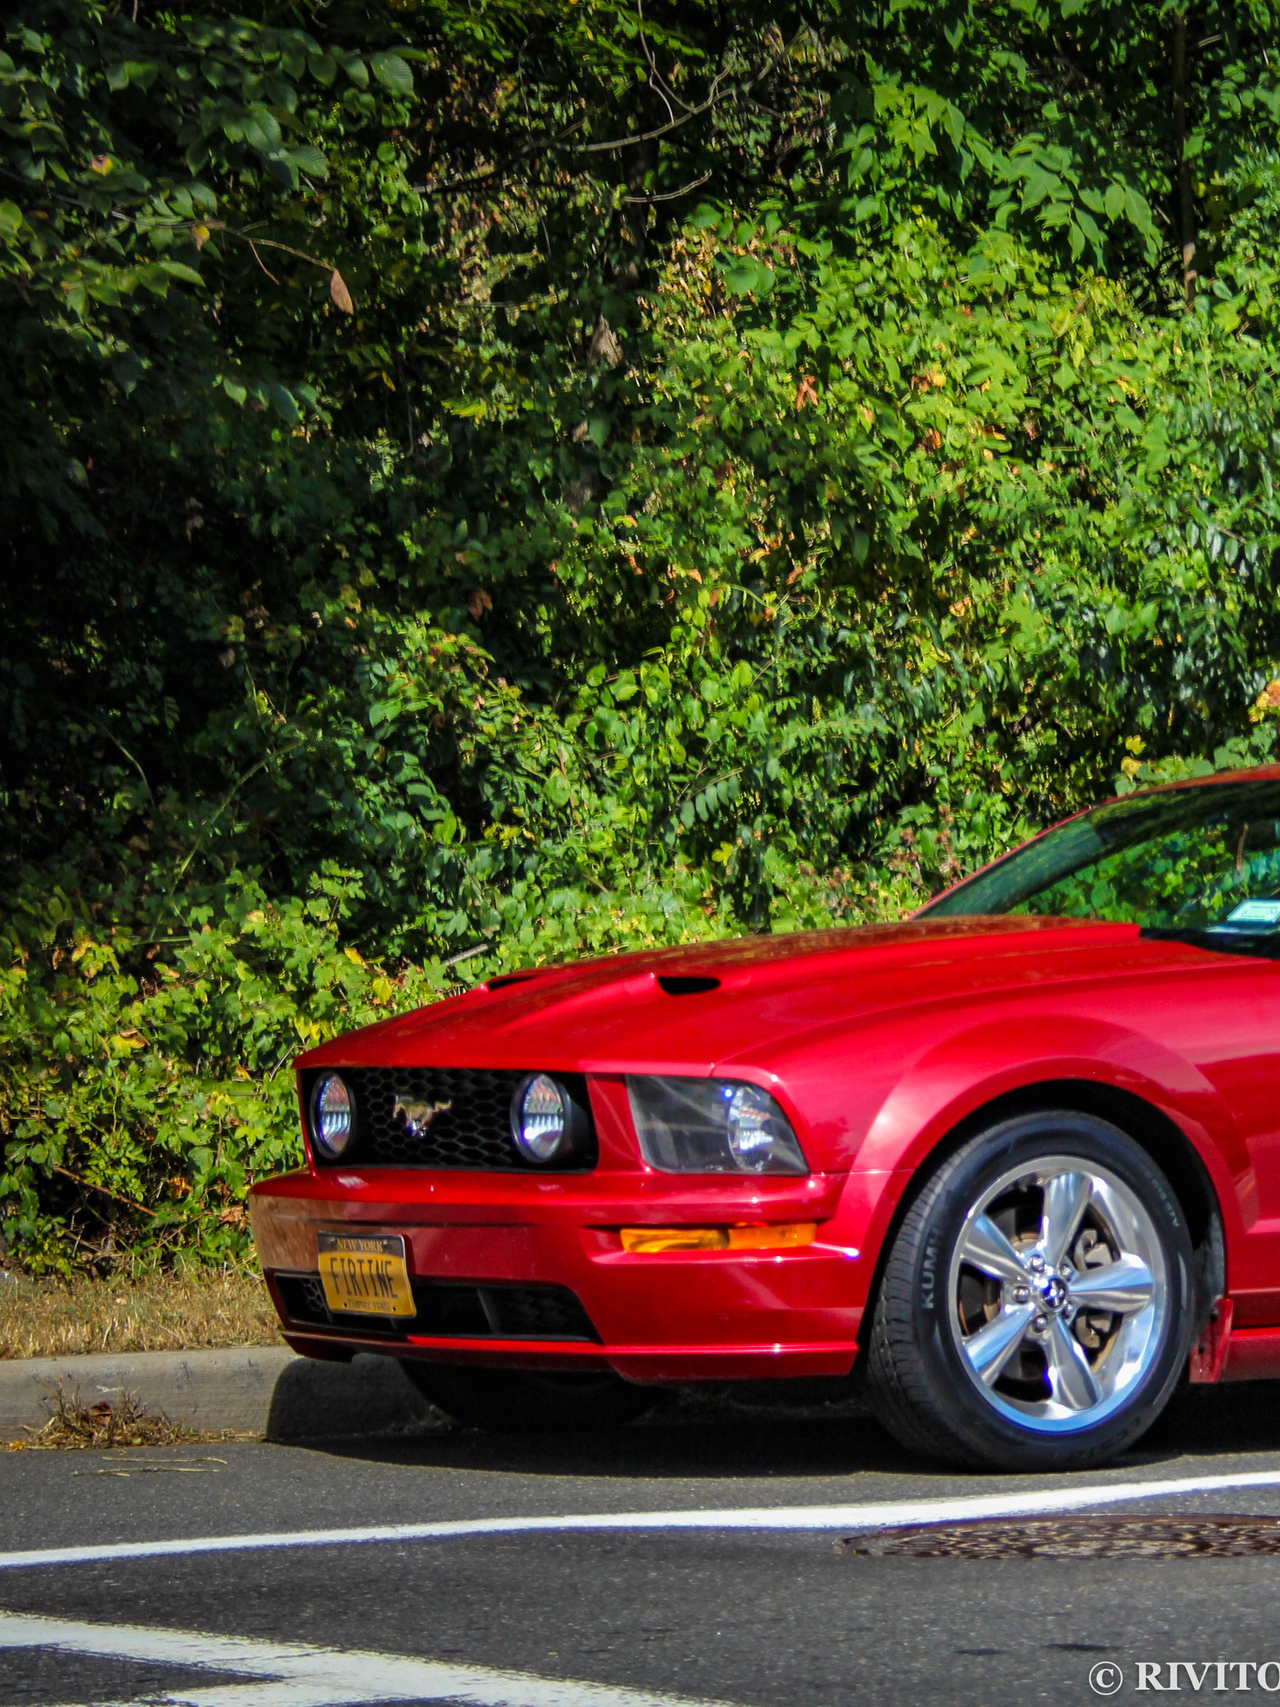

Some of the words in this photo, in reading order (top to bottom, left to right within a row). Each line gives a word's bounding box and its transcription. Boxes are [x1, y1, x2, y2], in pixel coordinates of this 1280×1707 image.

[337, 1238, 358, 1251] NEW
[360, 1238, 384, 1252] YORK
[330, 1257, 399, 1299] FIRTINE
